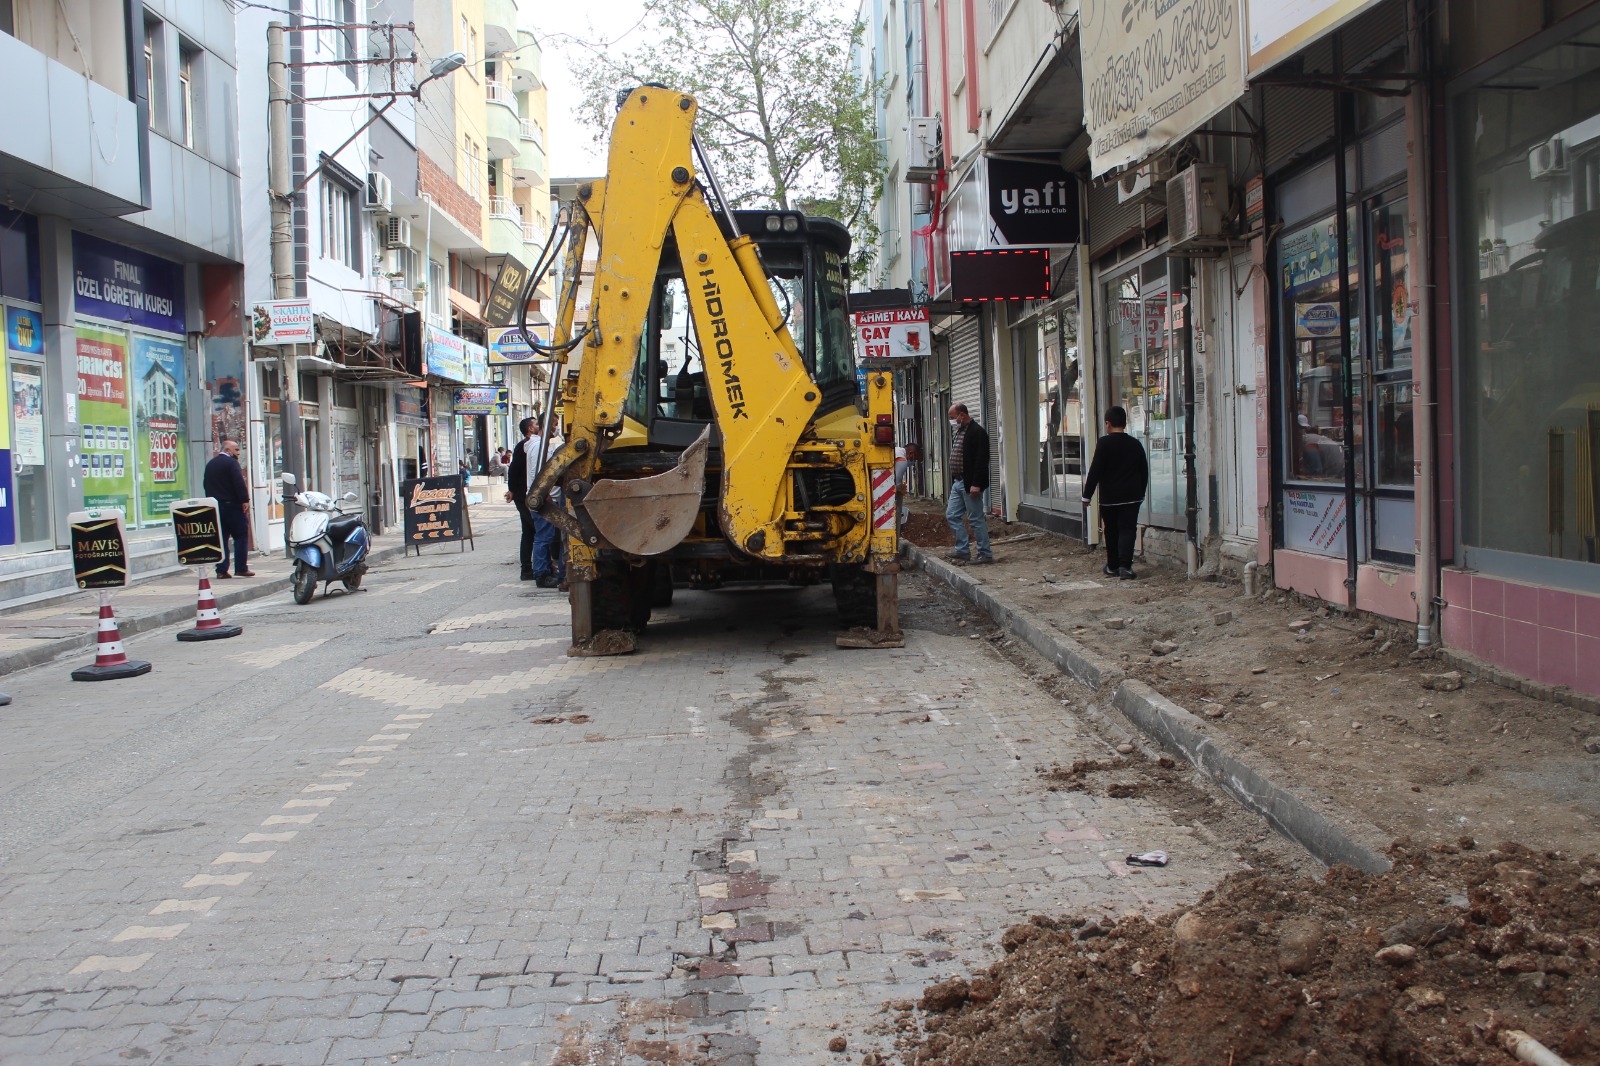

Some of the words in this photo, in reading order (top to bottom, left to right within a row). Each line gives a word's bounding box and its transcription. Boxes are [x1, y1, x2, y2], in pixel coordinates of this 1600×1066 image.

[1001, 181, 1067, 215] yafi
[114, 259, 141, 285] FİNAL
[76, 269, 103, 301] ÖZEL
[103, 277, 144, 311] ÖĞRETİM
[145, 293, 173, 317] KURSU
[860, 310, 895, 323] AHMET
[896, 309, 925, 321] KAYA
[502, 333, 535, 344] DENZ
[861, 326, 892, 343] ÇAY
[865, 342, 891, 358] EVİ
[149, 431, 178, 450] %100
[150, 451, 178, 470] BURS
[416, 520, 450, 531] TABELA
